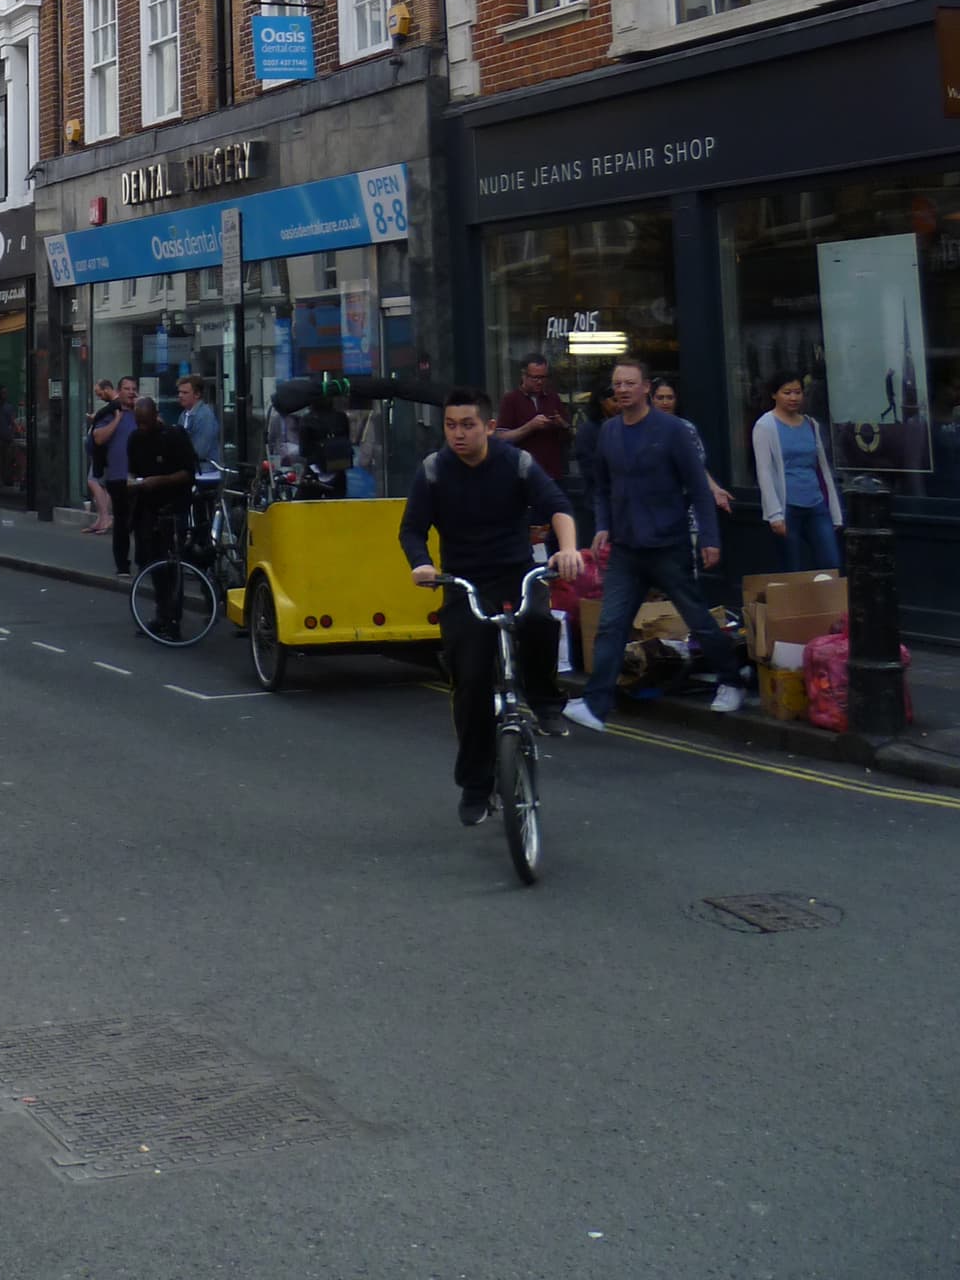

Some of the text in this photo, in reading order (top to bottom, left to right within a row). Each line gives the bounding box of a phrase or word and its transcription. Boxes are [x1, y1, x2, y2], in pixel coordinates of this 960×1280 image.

[261, 27, 305, 42] Oasis
[262, 43, 306, 53] dental care
[121, 141, 250, 205] DENTAL SURGERY
[479, 136, 715, 196] NUDIE JEANS REPAIR SHOP
[367, 174, 400, 198] OPEN
[280, 214, 362, 241] oasisdentalcare.co.uk
[373, 198, 407, 235] 8-8
[48, 241, 65, 256] OPEN
[151, 235, 184, 260] Oasis
[184, 225, 218, 256] dental
[52, 257, 70, 281] 8-8
[546, 310, 599, 338] FALL 2015
